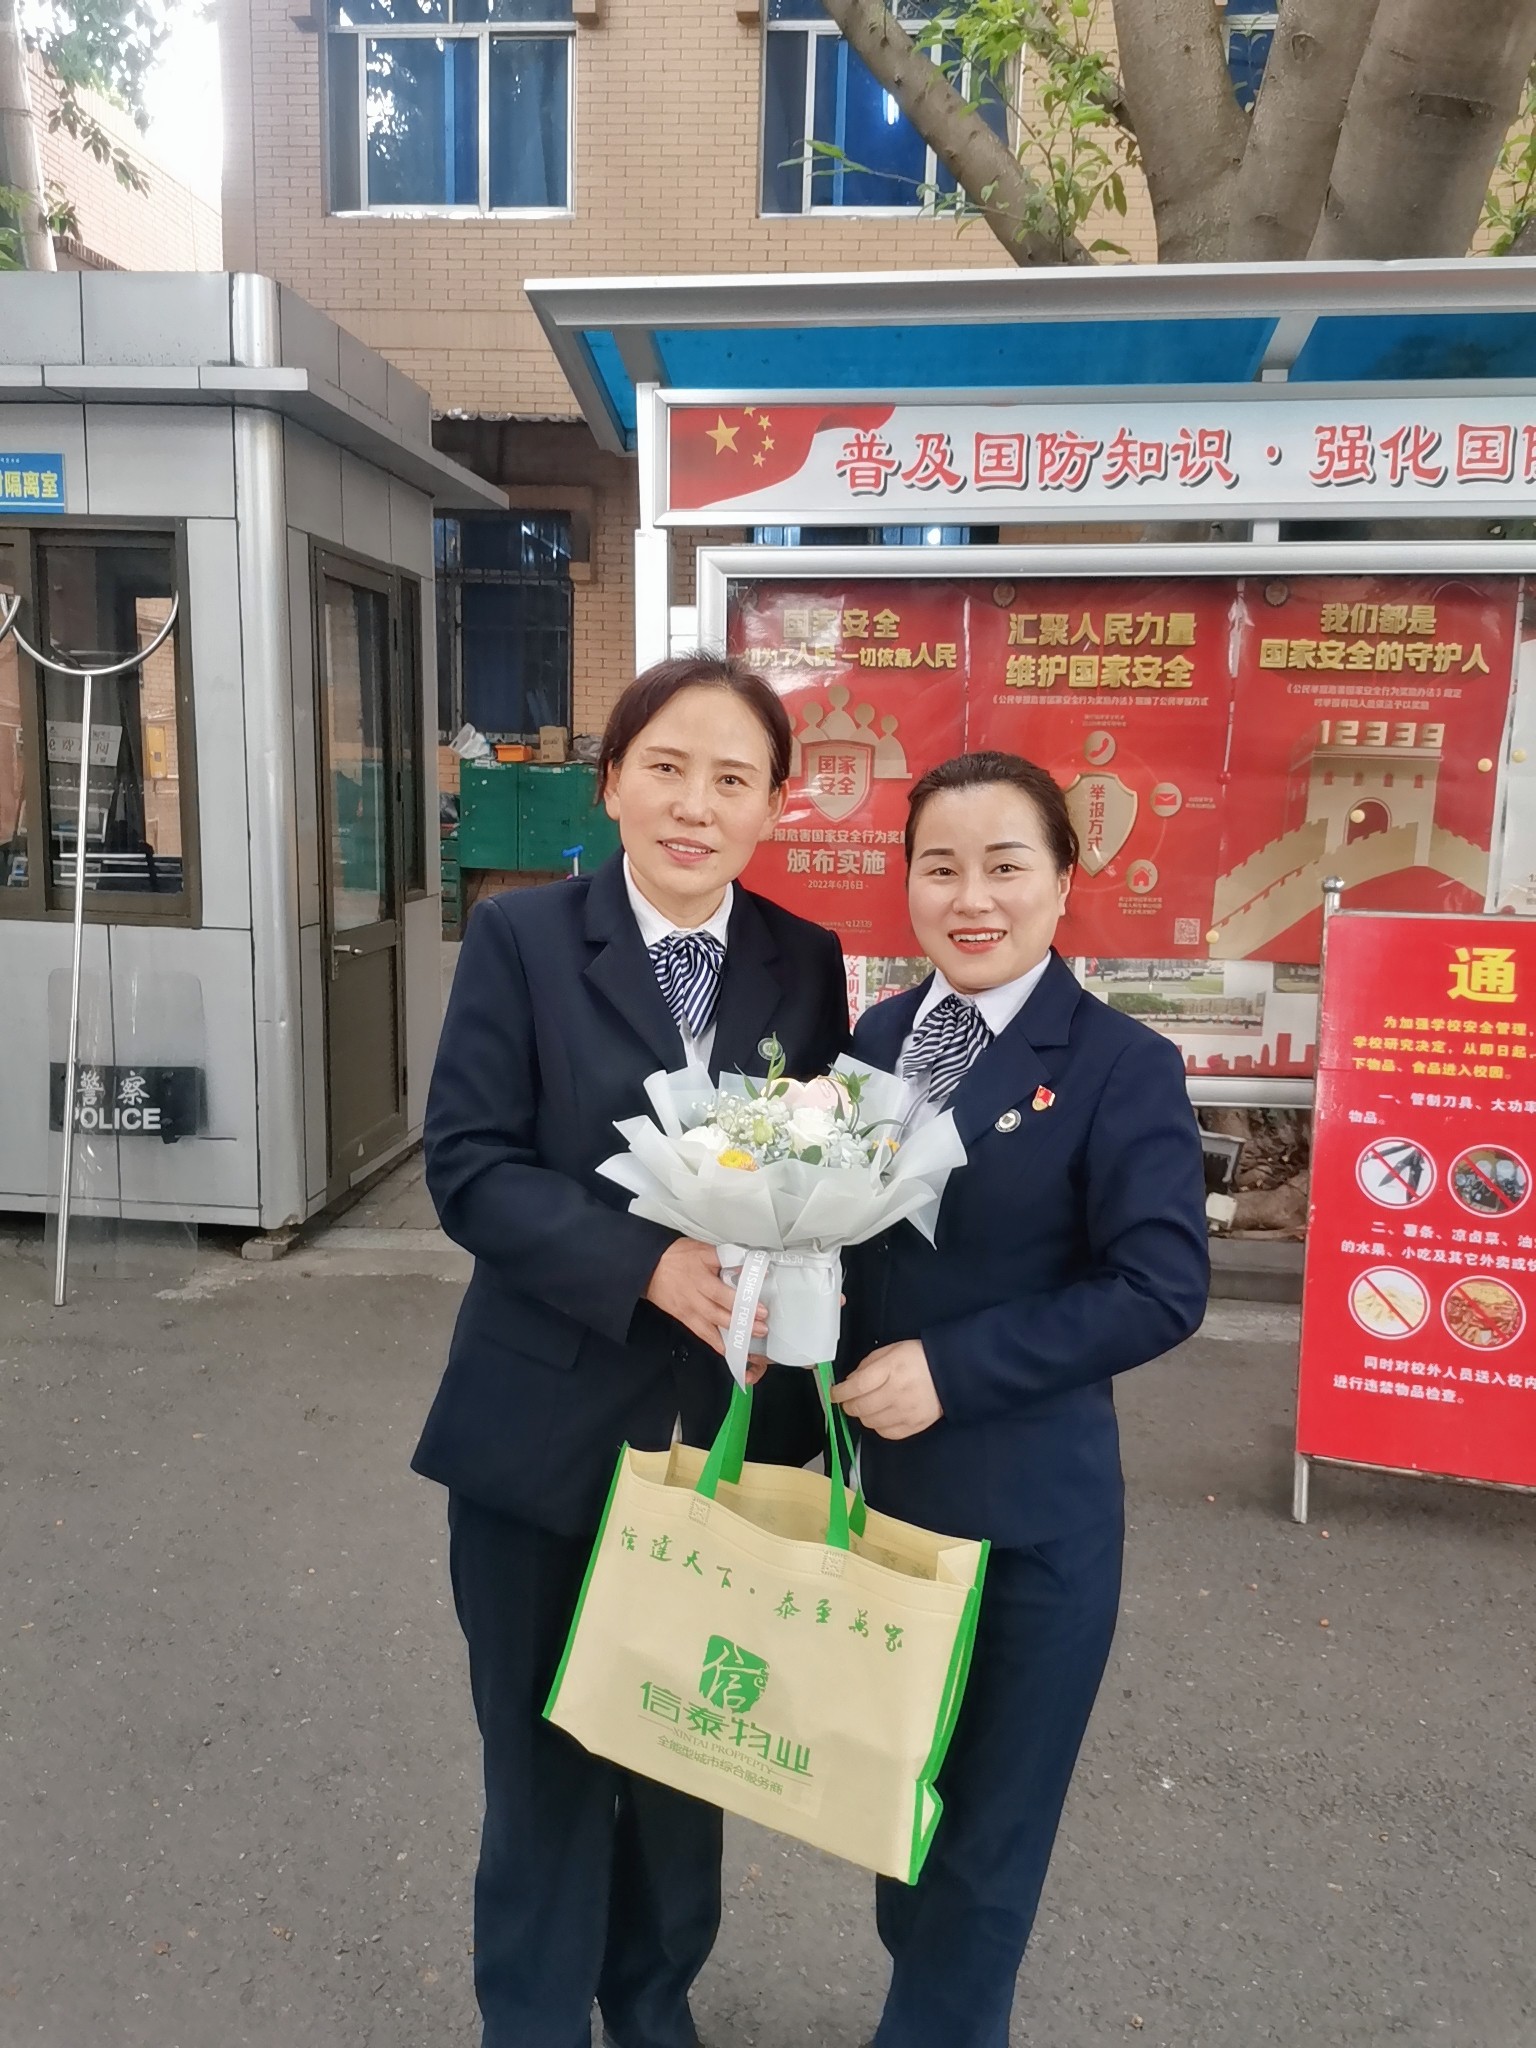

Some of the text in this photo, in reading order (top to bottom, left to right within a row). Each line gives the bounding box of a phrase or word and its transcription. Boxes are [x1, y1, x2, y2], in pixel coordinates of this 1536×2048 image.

[835, 422, 1536, 493] 普及国防知识·强化国
[0, 469, 59, 498] 隔离室
[783, 608, 900, 638] 国家安全
[1007, 612, 1197, 646] 汇聚人民力量
[1320, 603, 1437, 634] 我们都是
[841, 642, 958, 669] 一切依靠人民
[1259, 639, 1490, 673] 国家安全的守护人
[1005, 655, 1195, 688] 维护国家安全
[1320, 720, 1446, 748] 12339
[818, 755, 857, 774] 国家
[818, 776, 856, 796] 安全
[1087, 783, 1106, 851] 举报方式
[766, 828, 905, 844] 报危害国家安全行为奖
[786, 848, 887, 875] 颁布实施
[1447, 947, 1518, 1003] 通
[1352, 1035, 1536, 1059] 学校研究决定，从即日起，
[77, 1069, 151, 1107] 警察
[1371, 1220, 1536, 1249] 二、薯条、凉卤菜、油
[733, 1250, 768, 1349] EST WISHES FOR YOU
[639, 1680, 814, 1778] 信泰物业
[656, 1734, 784, 1796] 全能型城市综合服务商
